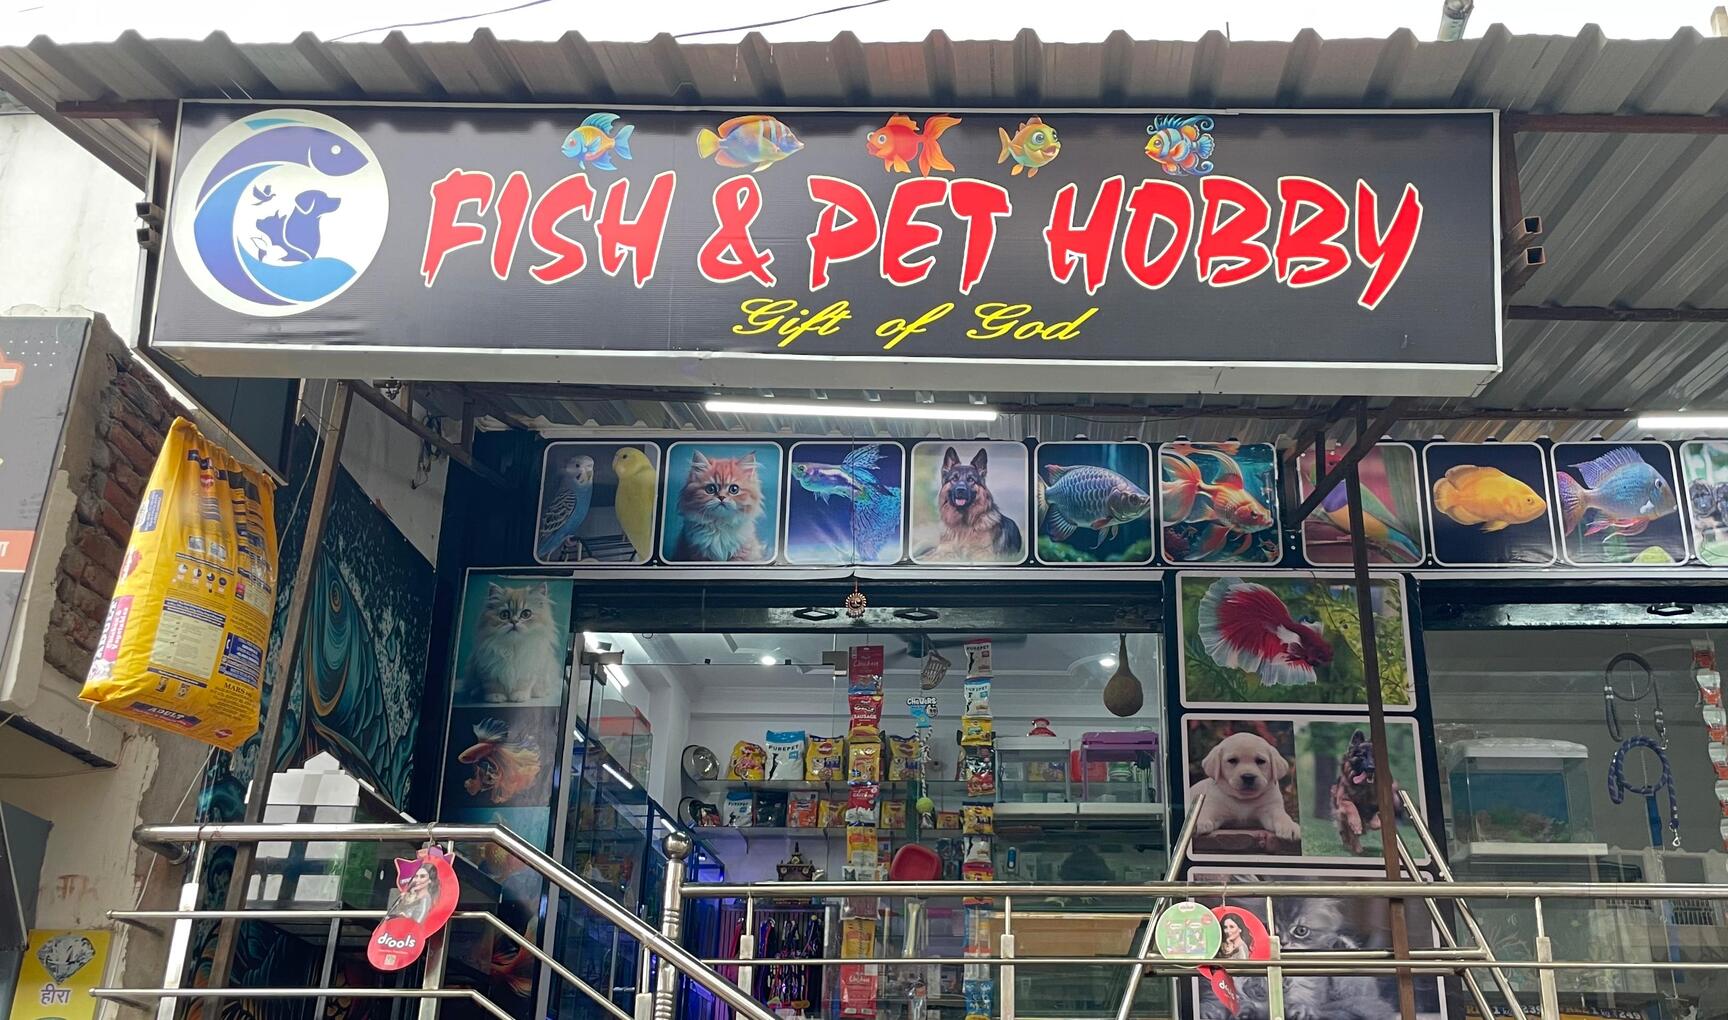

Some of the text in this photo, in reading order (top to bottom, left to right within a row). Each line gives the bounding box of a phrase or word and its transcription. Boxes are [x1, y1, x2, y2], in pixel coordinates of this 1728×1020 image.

[421, 169, 1424, 311] FISH & PET HOBBY
[731, 298, 1099, 350] Gift of God
[148, 707, 185, 719] ADULT
[377, 932, 416, 949] drools
[40, 983, 71, 1005] हीरा
